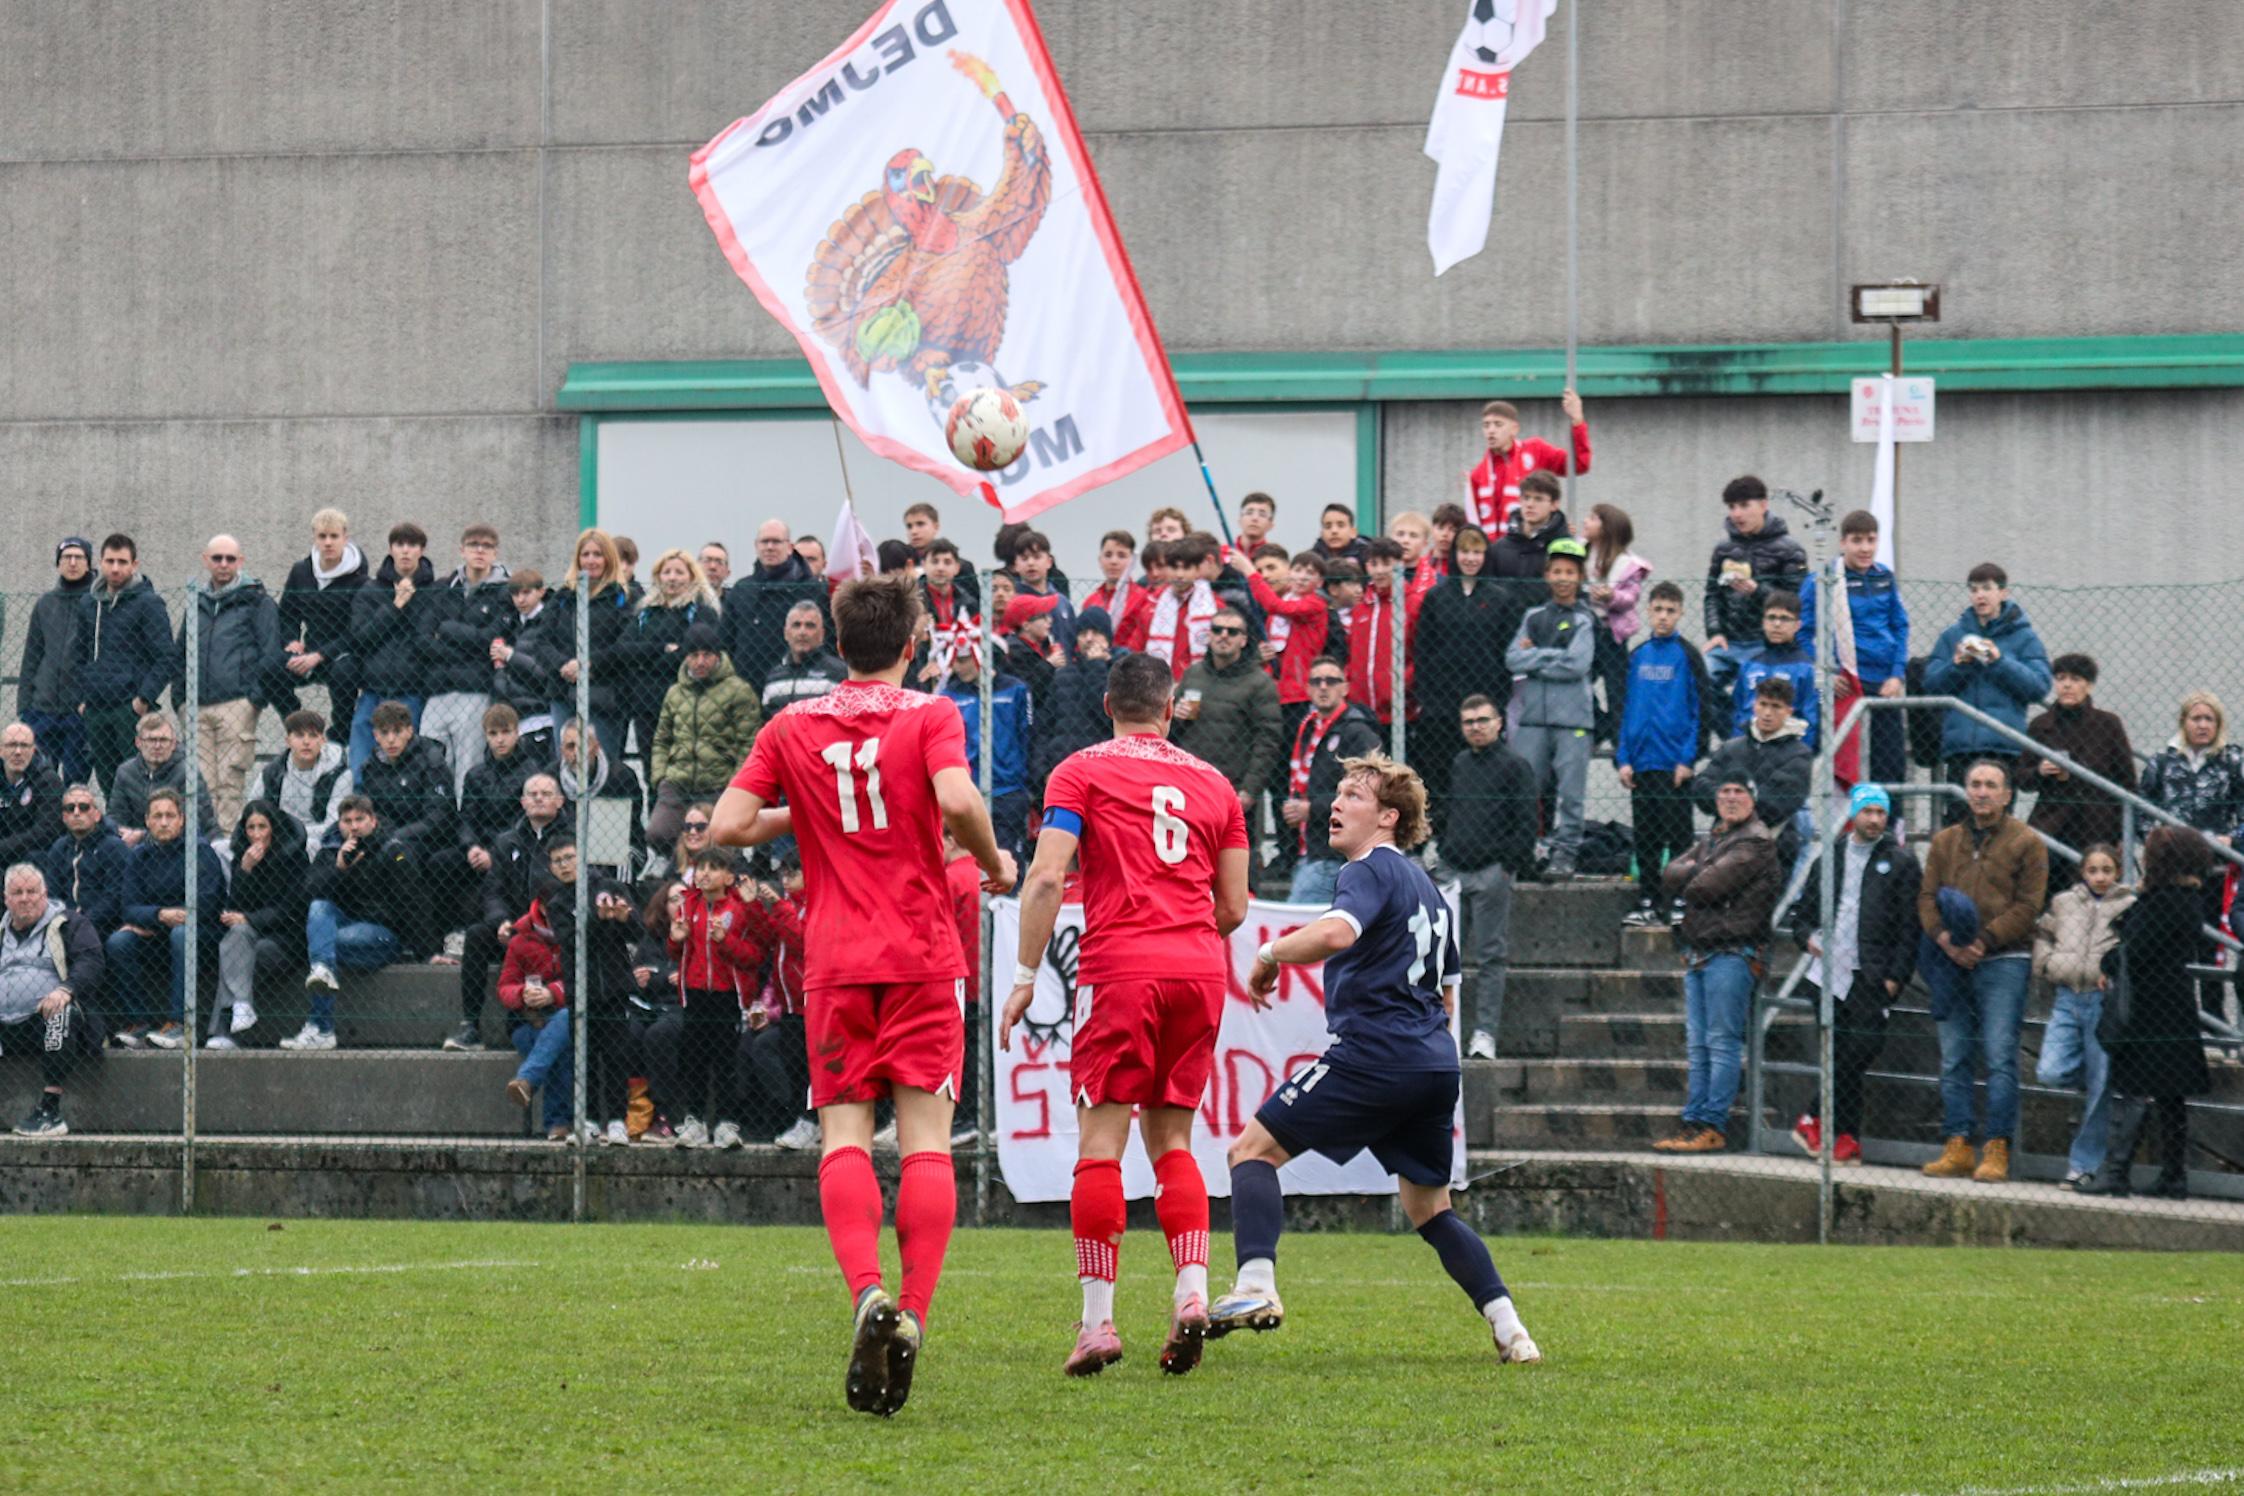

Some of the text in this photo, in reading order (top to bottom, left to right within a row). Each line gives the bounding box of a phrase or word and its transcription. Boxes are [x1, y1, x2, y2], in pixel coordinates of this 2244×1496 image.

[821, 737, 889, 833] 11
[1152, 785, 1189, 865] 6
[1407, 902, 1449, 997] 11
[1291, 1058, 1330, 1093] 11
